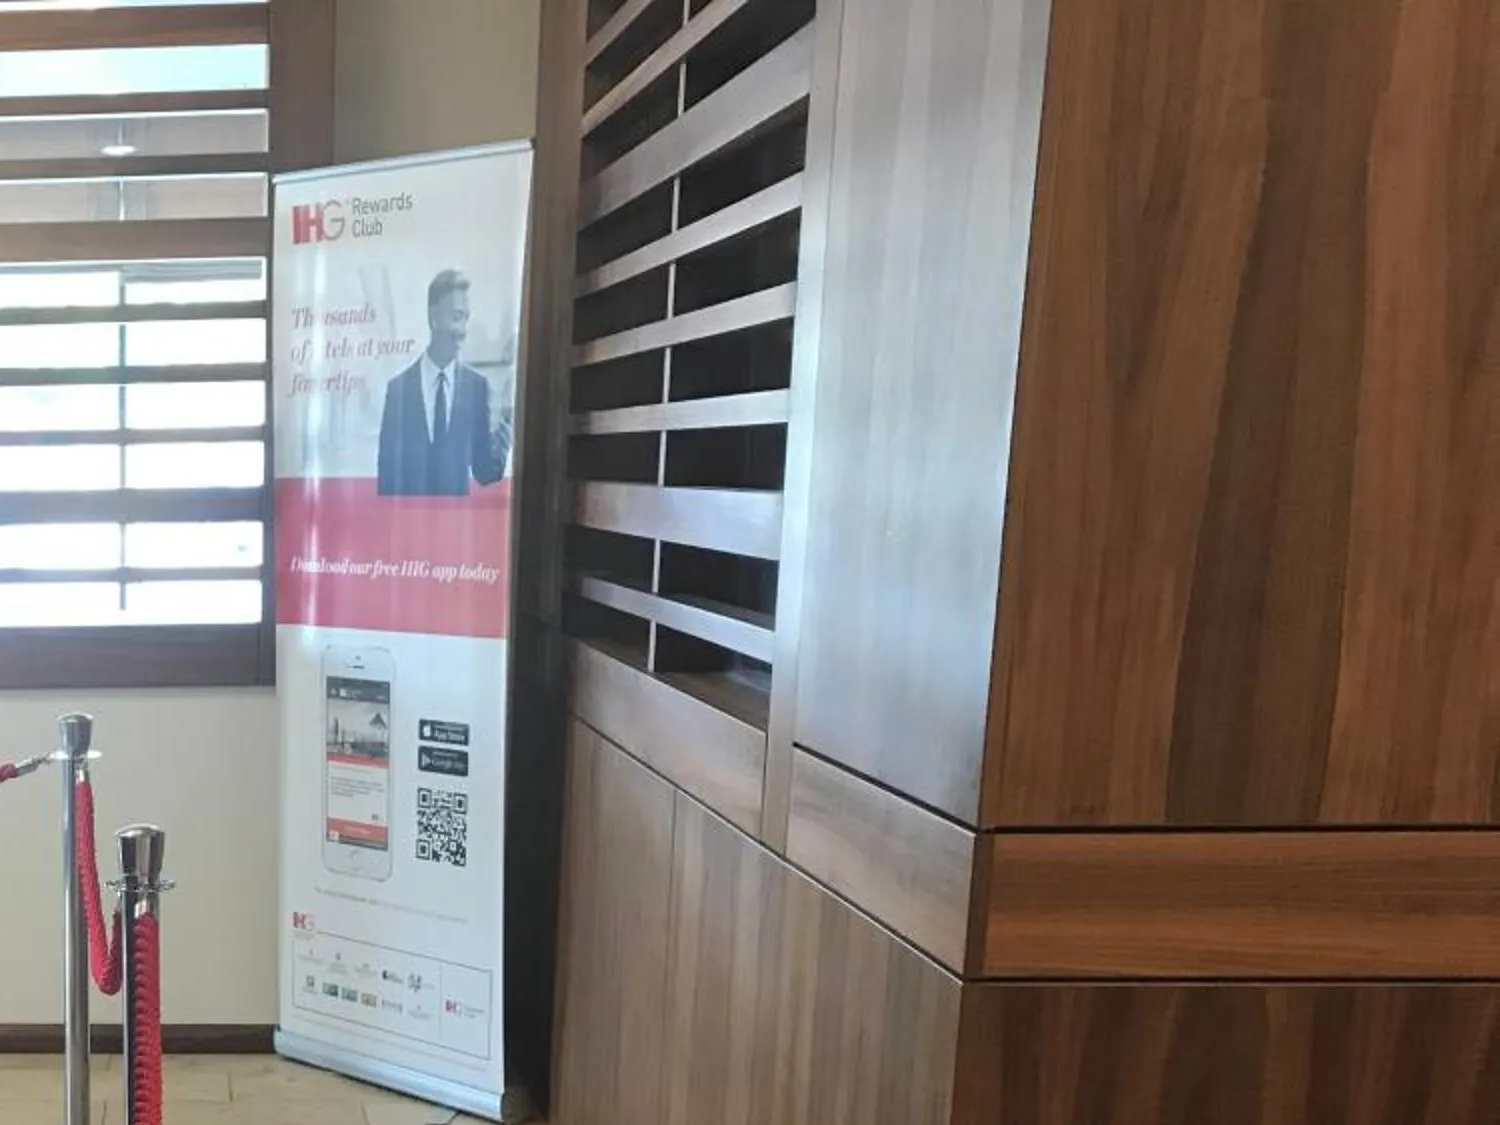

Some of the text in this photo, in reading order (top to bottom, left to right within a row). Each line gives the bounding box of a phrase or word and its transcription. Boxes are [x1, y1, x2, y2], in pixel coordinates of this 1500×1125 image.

[351, 192, 413, 215] Rewards
[292, 199, 345, 245] IHG
[351, 217, 383, 238] Club
[291, 303, 376, 329] Thusands
[311, 337, 353, 359] tels
[291, 556, 350, 576] Dwnload
[369, 559, 399, 580] free
[431, 565, 457, 584] app
[458, 561, 499, 585] today
